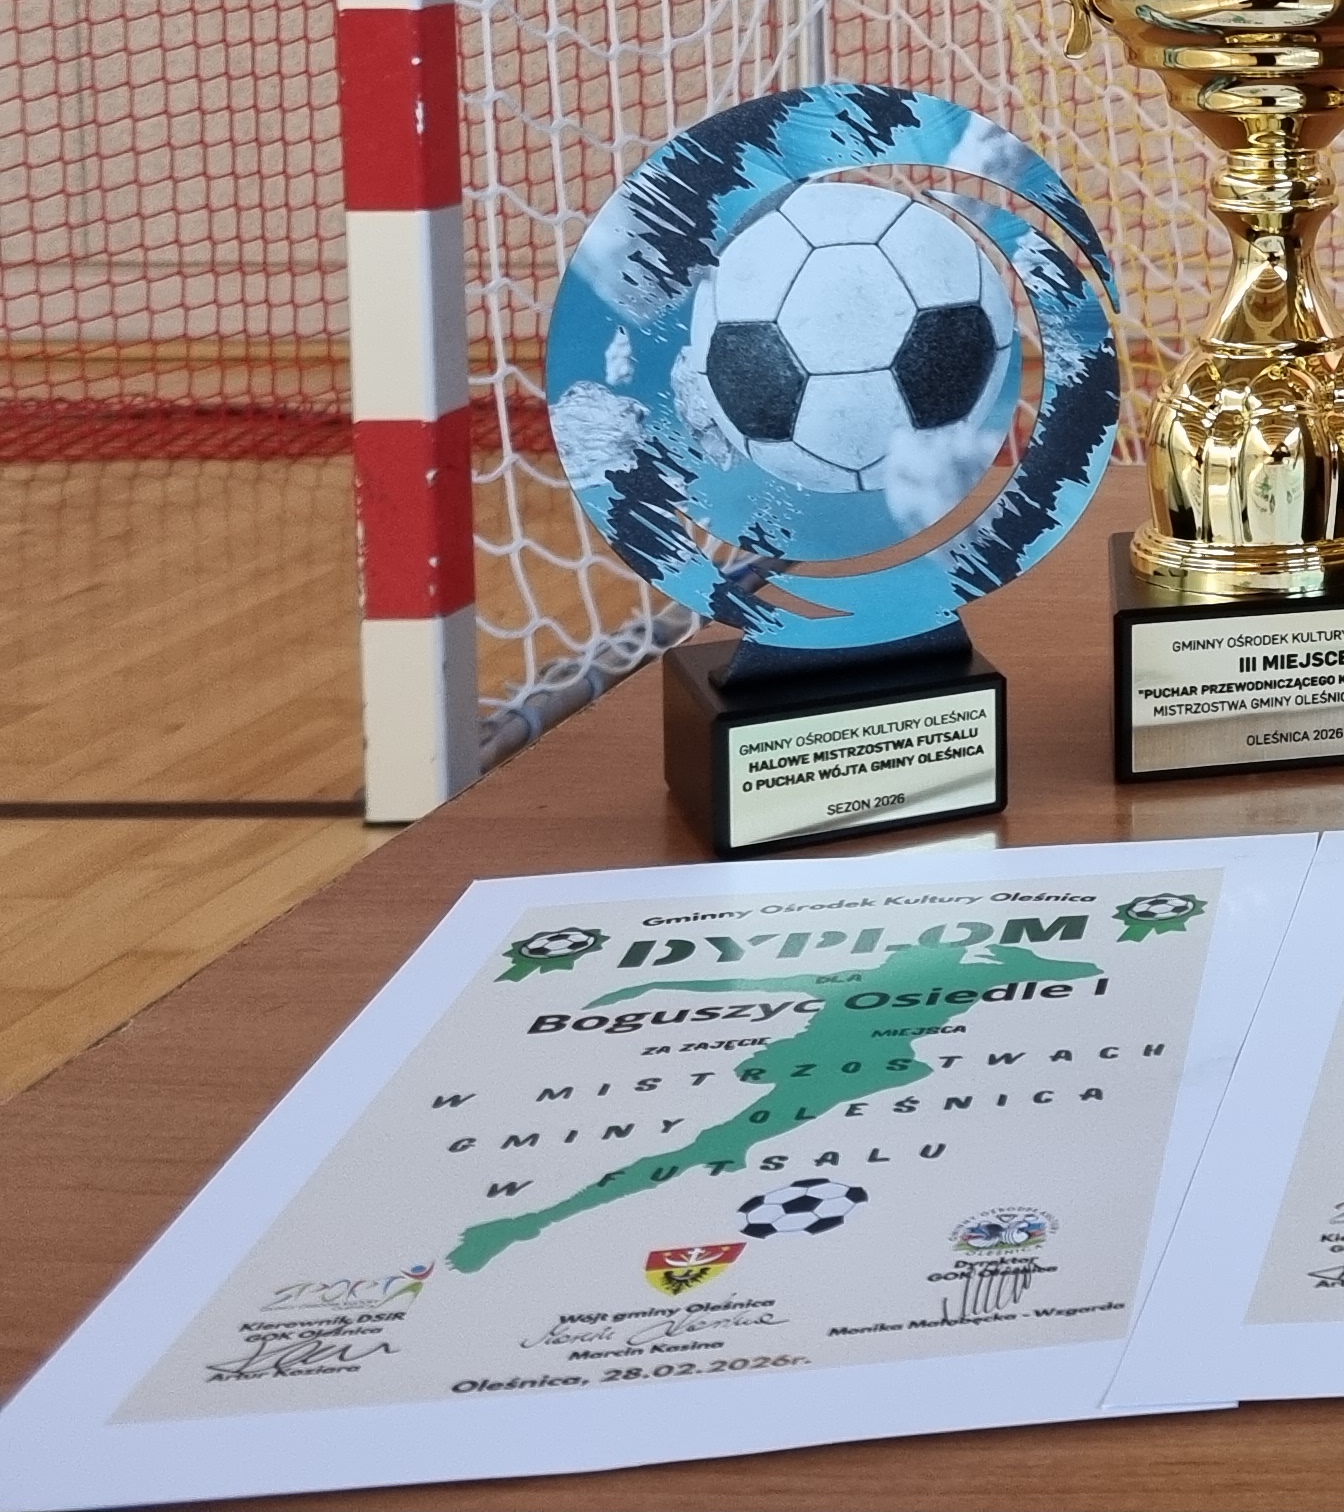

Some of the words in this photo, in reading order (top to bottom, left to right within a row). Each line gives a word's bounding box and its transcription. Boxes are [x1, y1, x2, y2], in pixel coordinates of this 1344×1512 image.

[1172, 638, 1224, 652] GMINNY
[1227, 633, 1289, 648] OŚRODEK
[1239, 656, 1257, 672] III
[1153, 698, 1247, 717] MISTRZOSTWA
[1251, 696, 1292, 710] GMINY
[1201, 676, 1335, 695] PRZEWODNICZĄCEGO
[739, 739, 792, 756] GMINNY
[795, 726, 859, 748] OŚRODEK
[862, 718, 921, 737] KULTURY
[924, 708, 987, 728] OLEŚNICA
[748, 753, 810, 773] HALOWE
[813, 738, 913, 763] MISTRZOSTWA
[917, 727, 978, 746] FUTSALU
[1246, 730, 1310, 746] OLEŚNICA
[1313, 728, 1343, 740] 2026
[742, 781, 752, 793] O
[755, 771, 815, 790] PUCHAR
[818, 762, 868, 780] WÓJTA
[870, 756, 915, 772] GMINY
[918, 744, 984, 763] OLEŚNICA
[827, 798, 871, 816] SEZON
[874, 793, 905, 810] 2026
[642, 910, 753, 928] Gminny
[759, 898, 878, 915] Ośrodek
[883, 894, 984, 907] Kultury
[989, 892, 1097, 903] Oleśnica
[616, 914, 1089, 968] DYPLOM
[526, 998, 825, 1034] Boguszyc
[844, 981, 1073, 1010] Osiedle
[431, 1093, 476, 1109] W
[536, 1043, 1165, 1102] MISTRZOSTWACH
[447, 1118, 684, 1153] GMINY
[749, 1088, 1104, 1124] OLEŚNICA
[486, 1180, 534, 1198] W
[598, 1143, 947, 1187] FUTSALU
[451, 1374, 589, 1394] Oleśnica,
[600, 1353, 812, 1383] 28.02.2026r.
